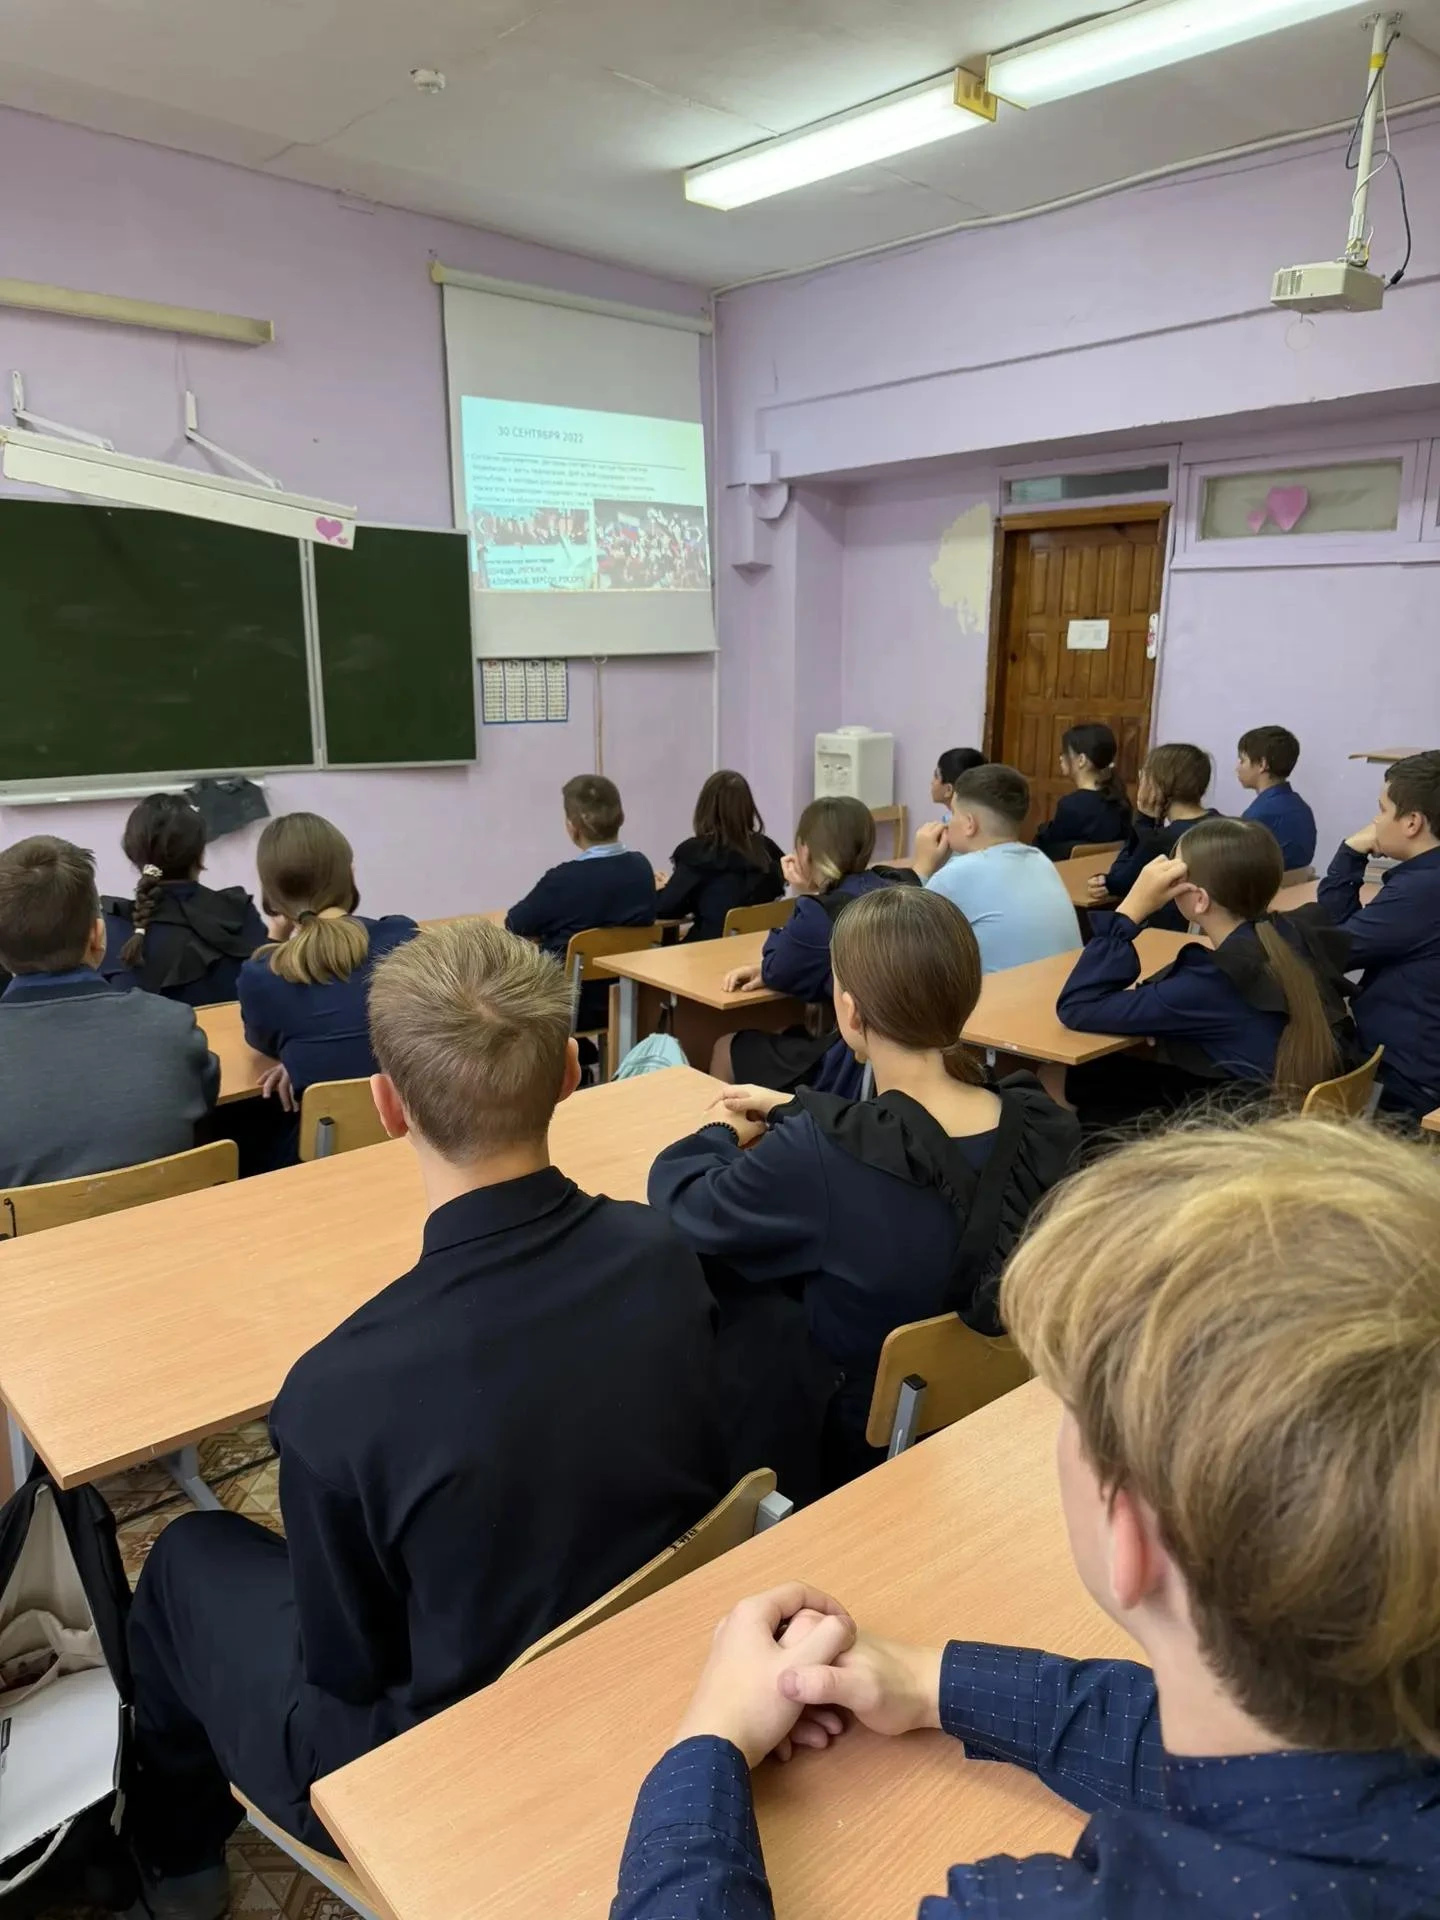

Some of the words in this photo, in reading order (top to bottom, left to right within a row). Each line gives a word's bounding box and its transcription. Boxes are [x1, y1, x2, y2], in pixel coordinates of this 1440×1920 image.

[497, 425, 510, 437] 30
[512, 426, 561, 440] СЕНТЯБРЯ
[563, 430, 584, 444] 2022
